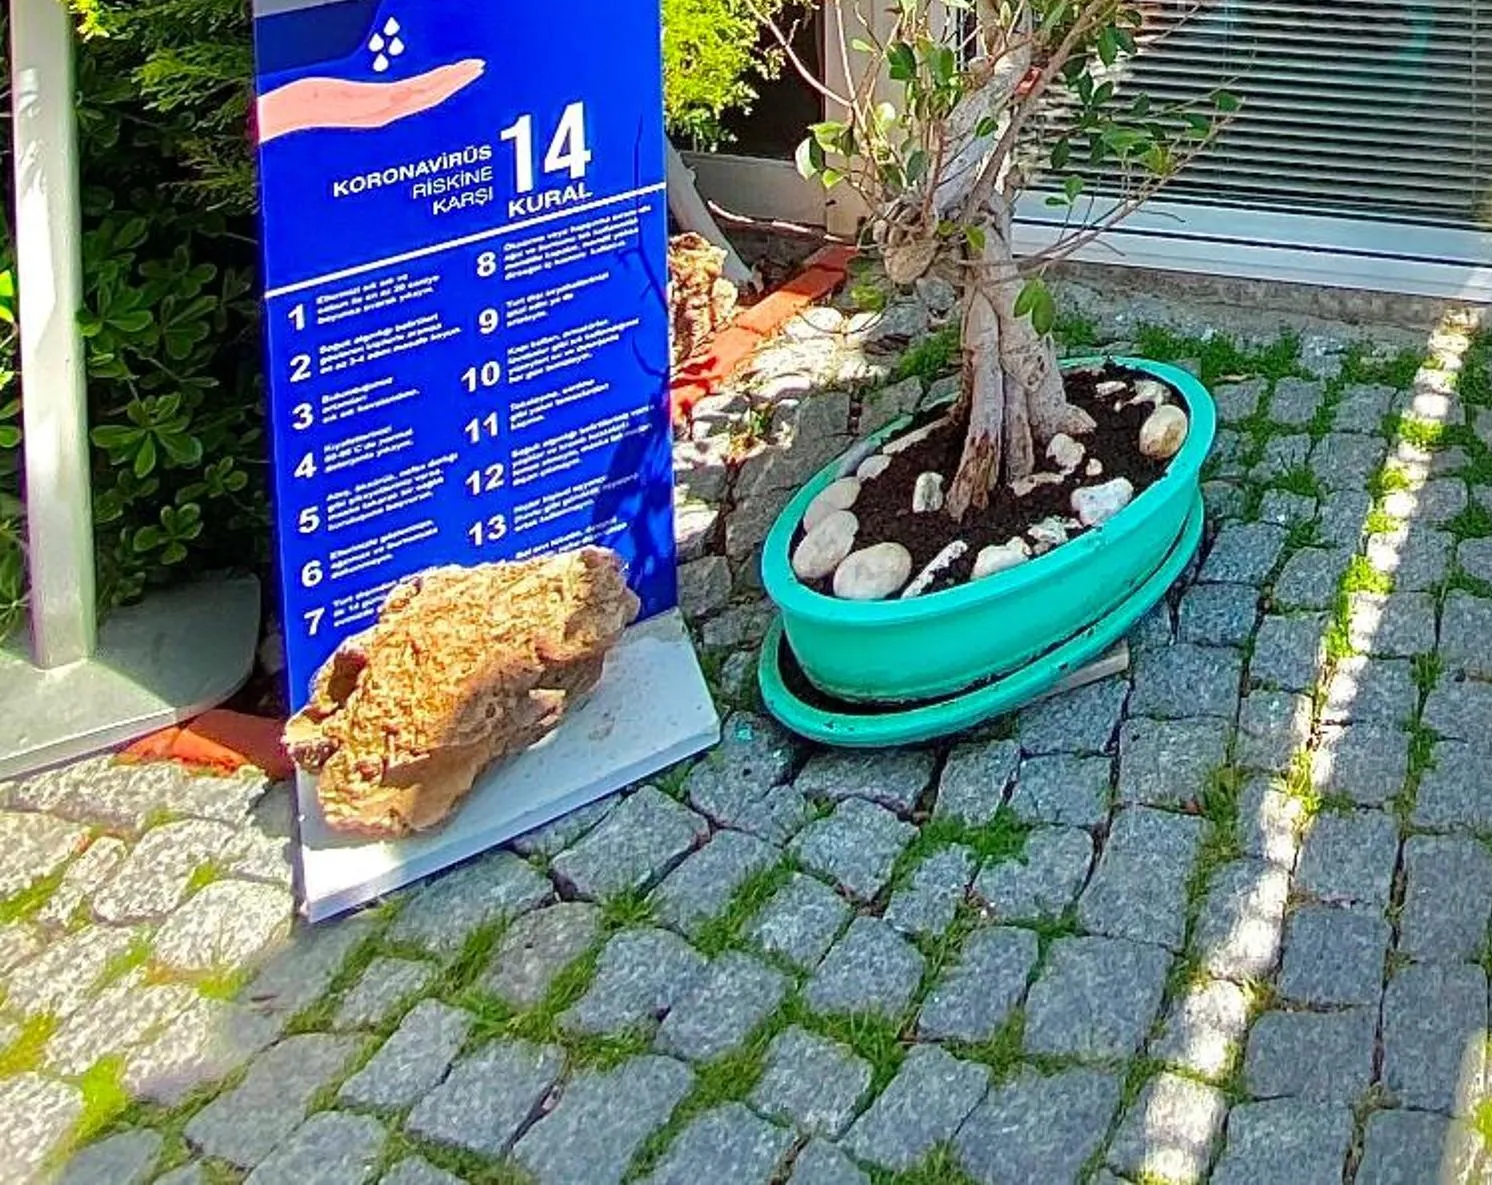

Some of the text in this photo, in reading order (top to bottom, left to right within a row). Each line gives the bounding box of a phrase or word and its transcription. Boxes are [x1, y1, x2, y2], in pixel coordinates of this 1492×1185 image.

[333, 101, 591, 197] KORONAVİRÜS 14
[412, 166, 493, 199] RİSKİNE
[432, 182, 593, 217] KARŞI KURAL
[477, 252, 496, 277] 8
[288, 303, 305, 331] 1
[479, 308, 498, 334] 9
[290, 354, 311, 383] 2
[461, 361, 500, 392] 10
[292, 403, 313, 430] 3
[465, 412, 498, 444] 11
[294, 452, 317, 478] 4
[465, 463, 504, 495] 12
[299, 506, 320, 533] 5
[469, 514, 506, 546] 13
[302, 560, 323, 587] 6
[304, 607, 325, 636] 7
